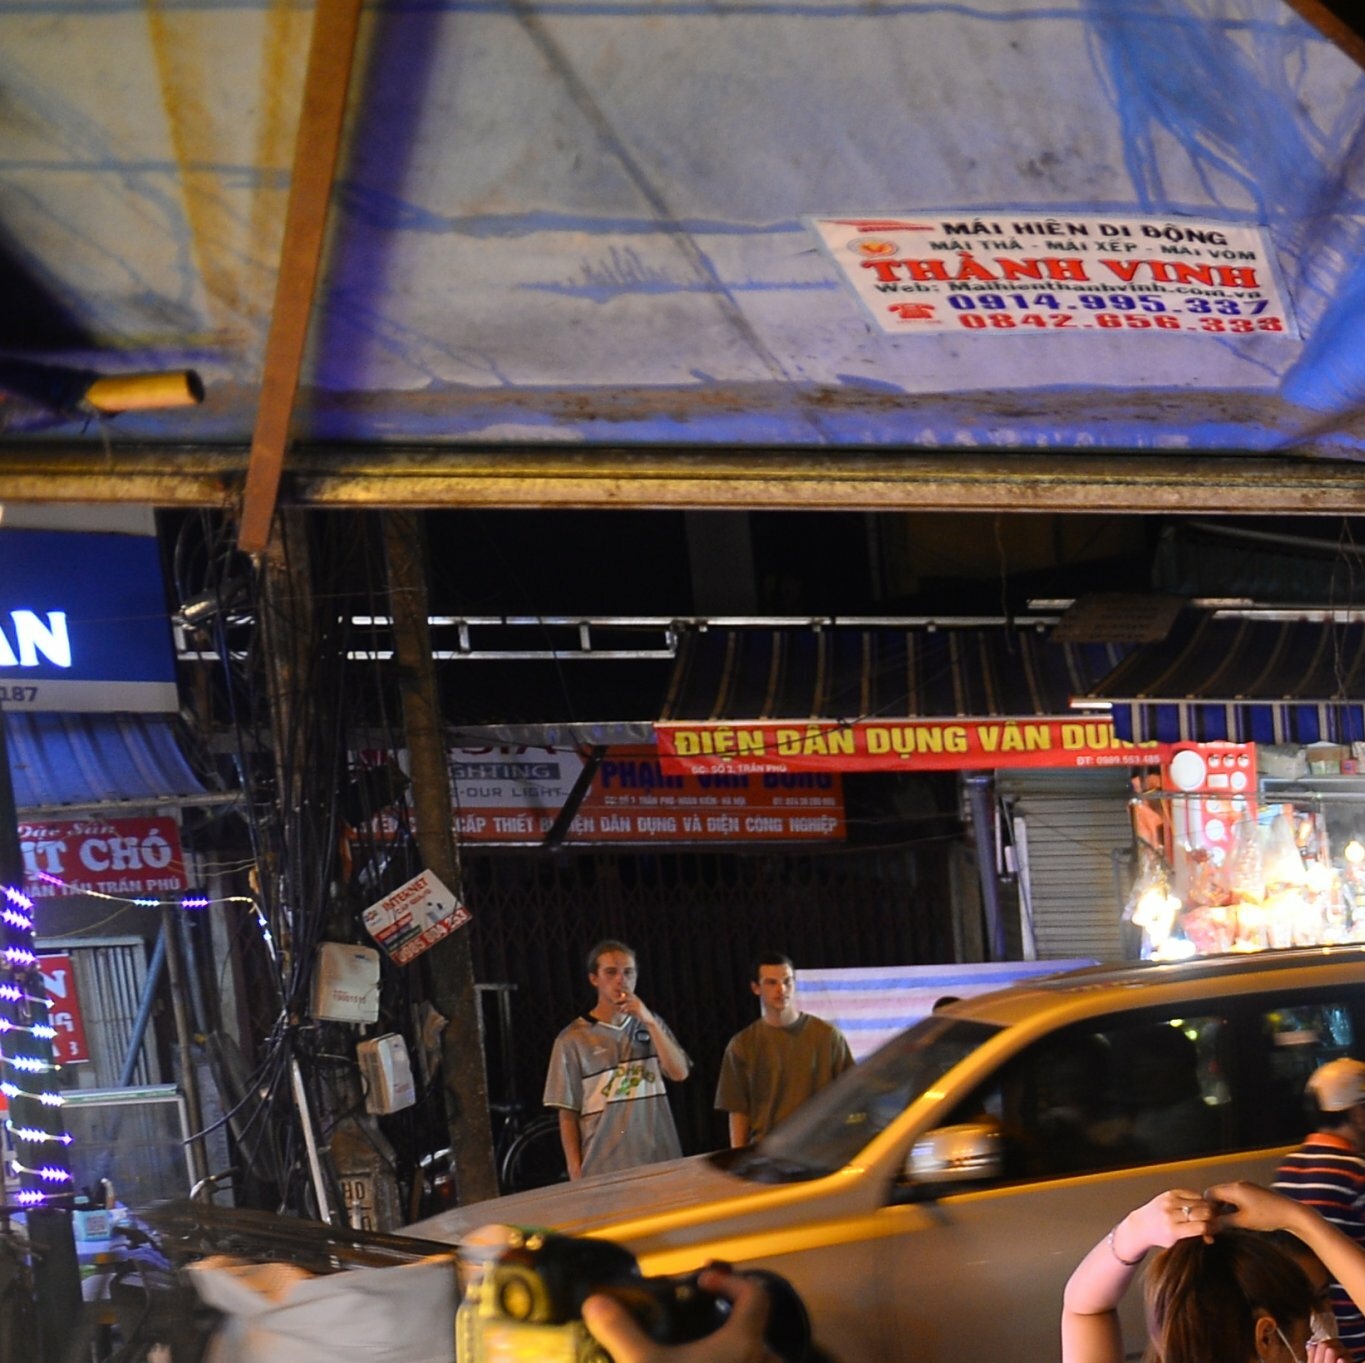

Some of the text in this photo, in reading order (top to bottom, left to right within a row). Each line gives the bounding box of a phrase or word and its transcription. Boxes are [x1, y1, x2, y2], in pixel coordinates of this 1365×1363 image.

[942, 219, 1228, 247] MÁI HIÊN DI ĐỘNG
[861, 250, 1262, 289] THÀNH VINH
[876, 282, 940, 294] Web:
[947, 293, 1271, 316] 0914.995.337
[674, 726, 766, 762] ĐIỆN
[776, 723, 854, 756] DÂN
[866, 727, 968, 760] DỤNG
[978, 719, 1051, 752] VÂN
[79, 828, 173, 872] CHÓ
